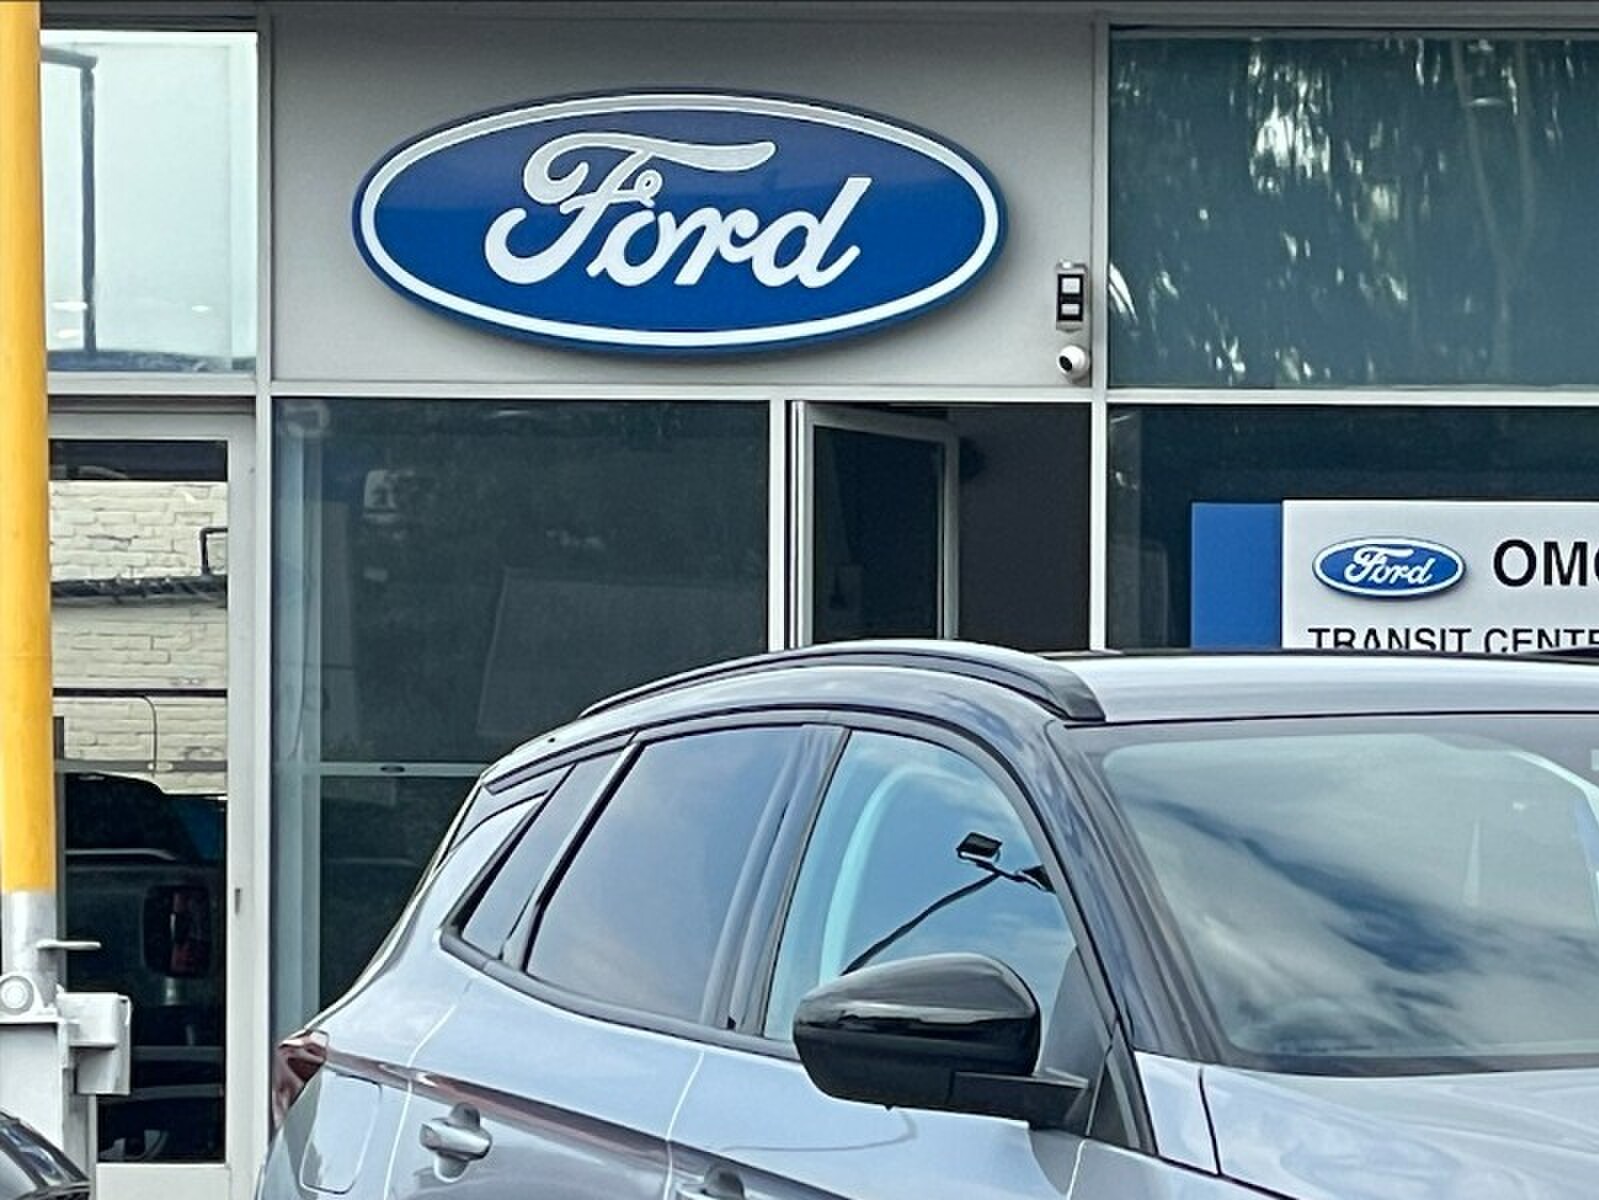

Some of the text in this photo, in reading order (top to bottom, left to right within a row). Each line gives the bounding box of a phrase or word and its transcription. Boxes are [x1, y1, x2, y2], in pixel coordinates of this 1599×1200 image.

[484, 132, 872, 288] Ford
[1344, 546, 1435, 584] Ford
[1307, 628, 1473, 651] TRANSIT
